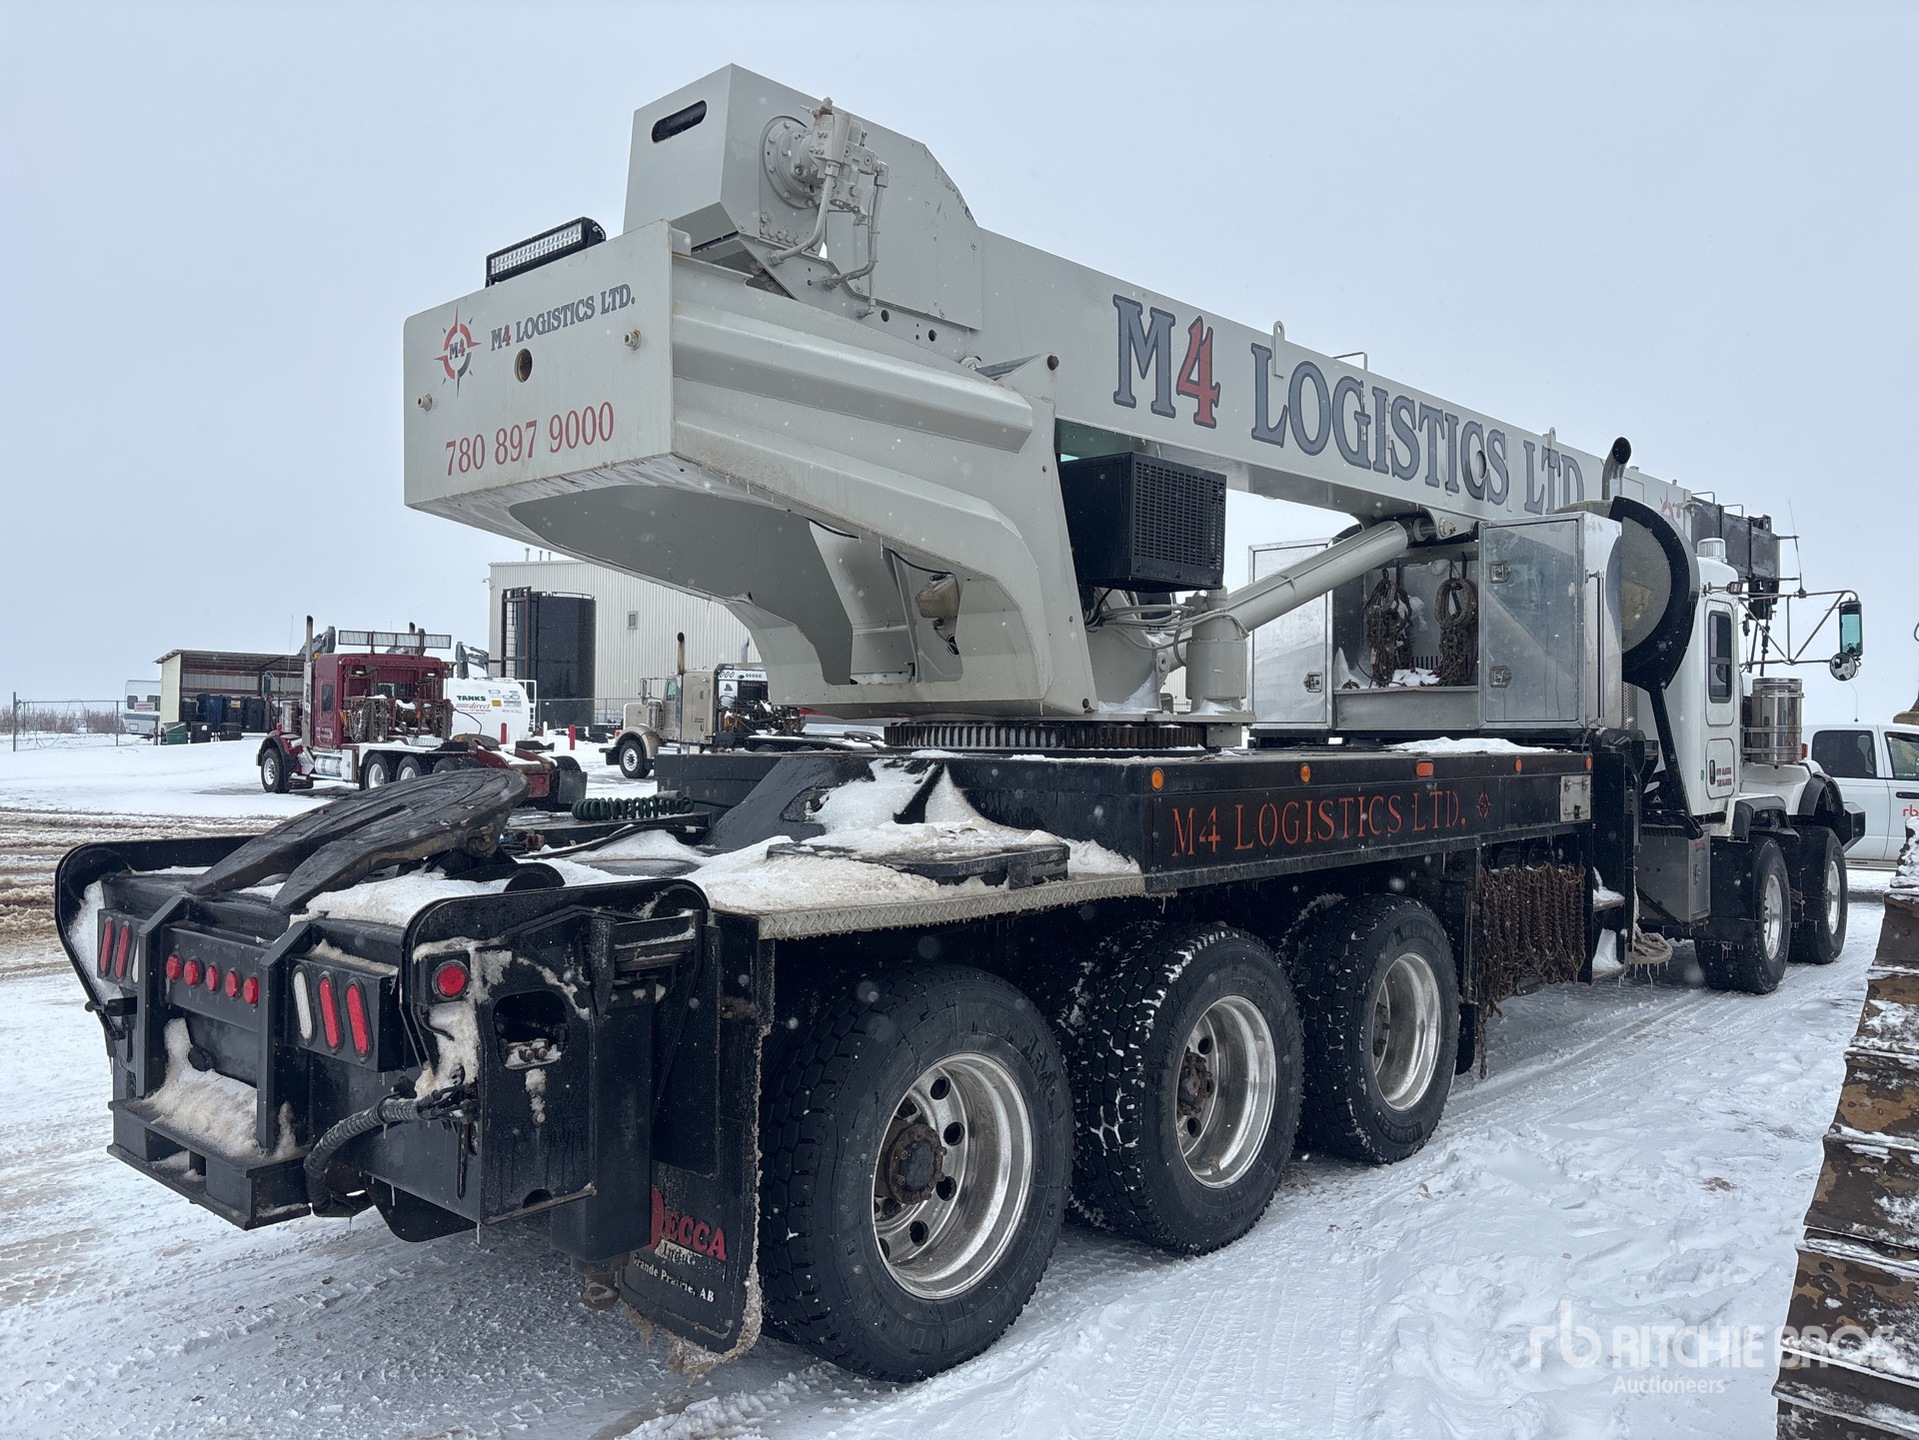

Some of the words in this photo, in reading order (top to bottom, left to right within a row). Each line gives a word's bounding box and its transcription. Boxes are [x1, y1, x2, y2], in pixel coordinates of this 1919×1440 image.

[449, 337, 466, 360] M4
[490, 324, 511, 351] M4
[515, 296, 596, 343] LOGISTICS
[600, 283, 636, 315] LTD.
[1112, 293, 1221, 429] M4
[1250, 342, 1510, 506] LOGISTICS
[445, 433, 486, 476] 780
[494, 419, 538, 465] 897
[549, 401, 615, 453] 9000
[1172, 806, 1221, 858] M4
[1234, 793, 1402, 850] LOGISTICS
[1413, 789, 1467, 832] LTD.
[632, 1254, 659, 1278] Grande
[699, 1287, 715, 1303] AB
